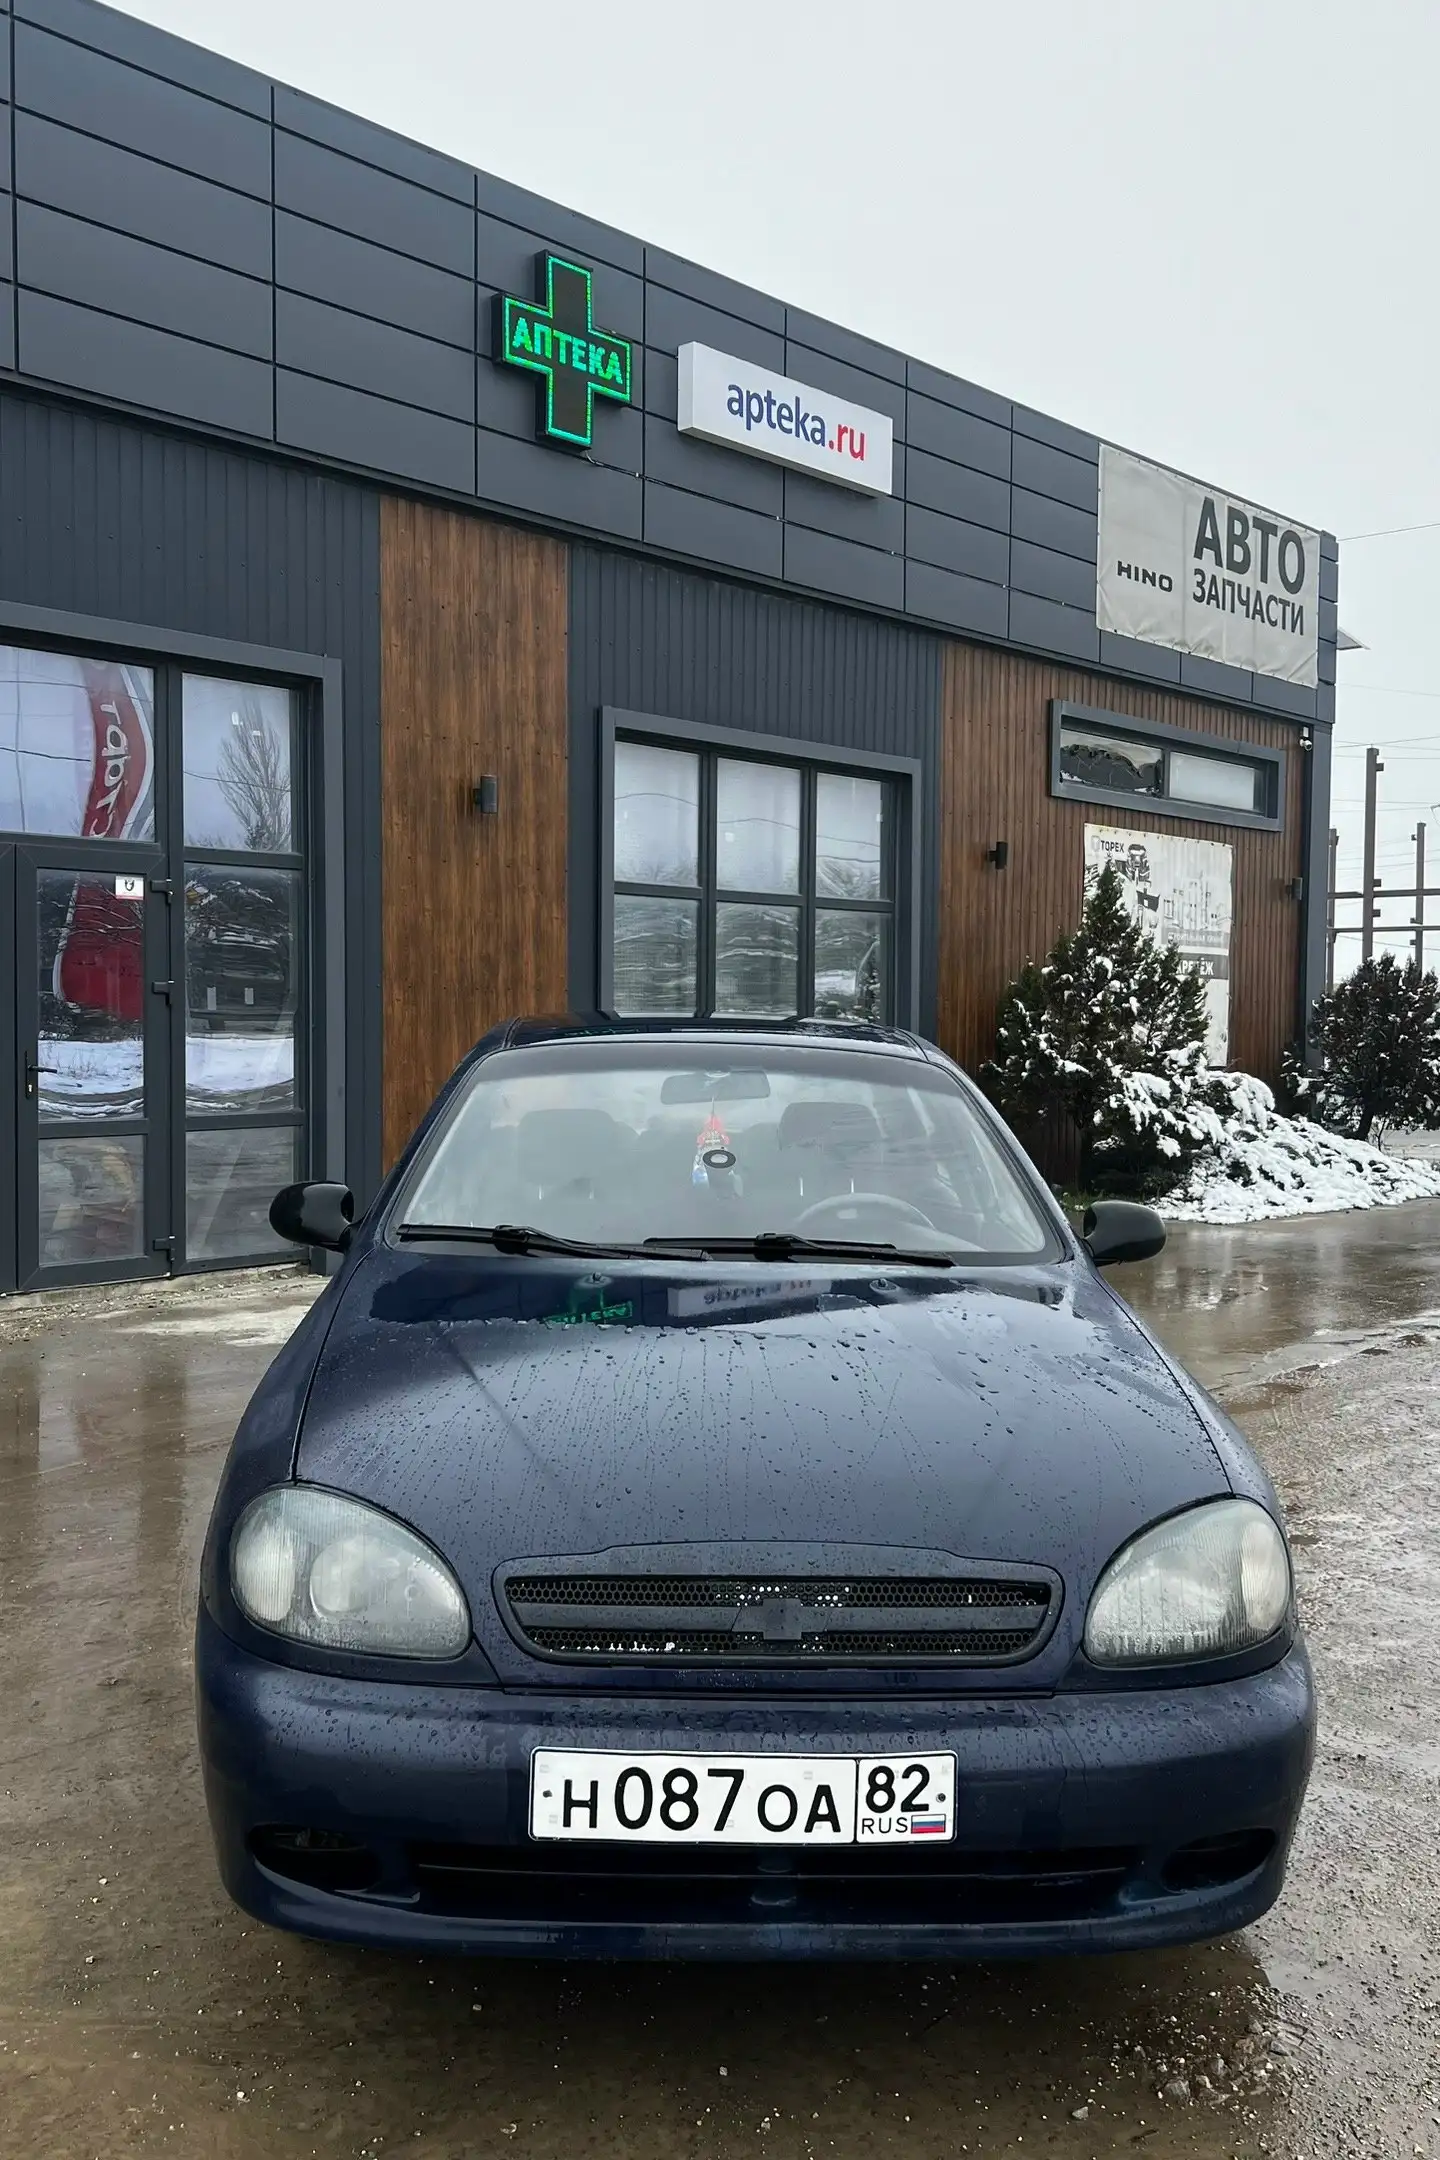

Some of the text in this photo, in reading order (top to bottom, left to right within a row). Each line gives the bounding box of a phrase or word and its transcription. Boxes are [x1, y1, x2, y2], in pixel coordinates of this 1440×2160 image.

[512, 317, 623, 384] АПТЕКА
[727, 384, 865, 461] apteka.ru
[1193, 496, 1306, 594] АВТО
[1117, 560, 1173, 593] HINO
[1193, 568, 1304, 636] ЗАПЧАСТИ
[1100, 840, 1124, 853] TOPEX
[865, 1764, 930, 1813] 82
[861, 1817, 908, 1834] RUS
